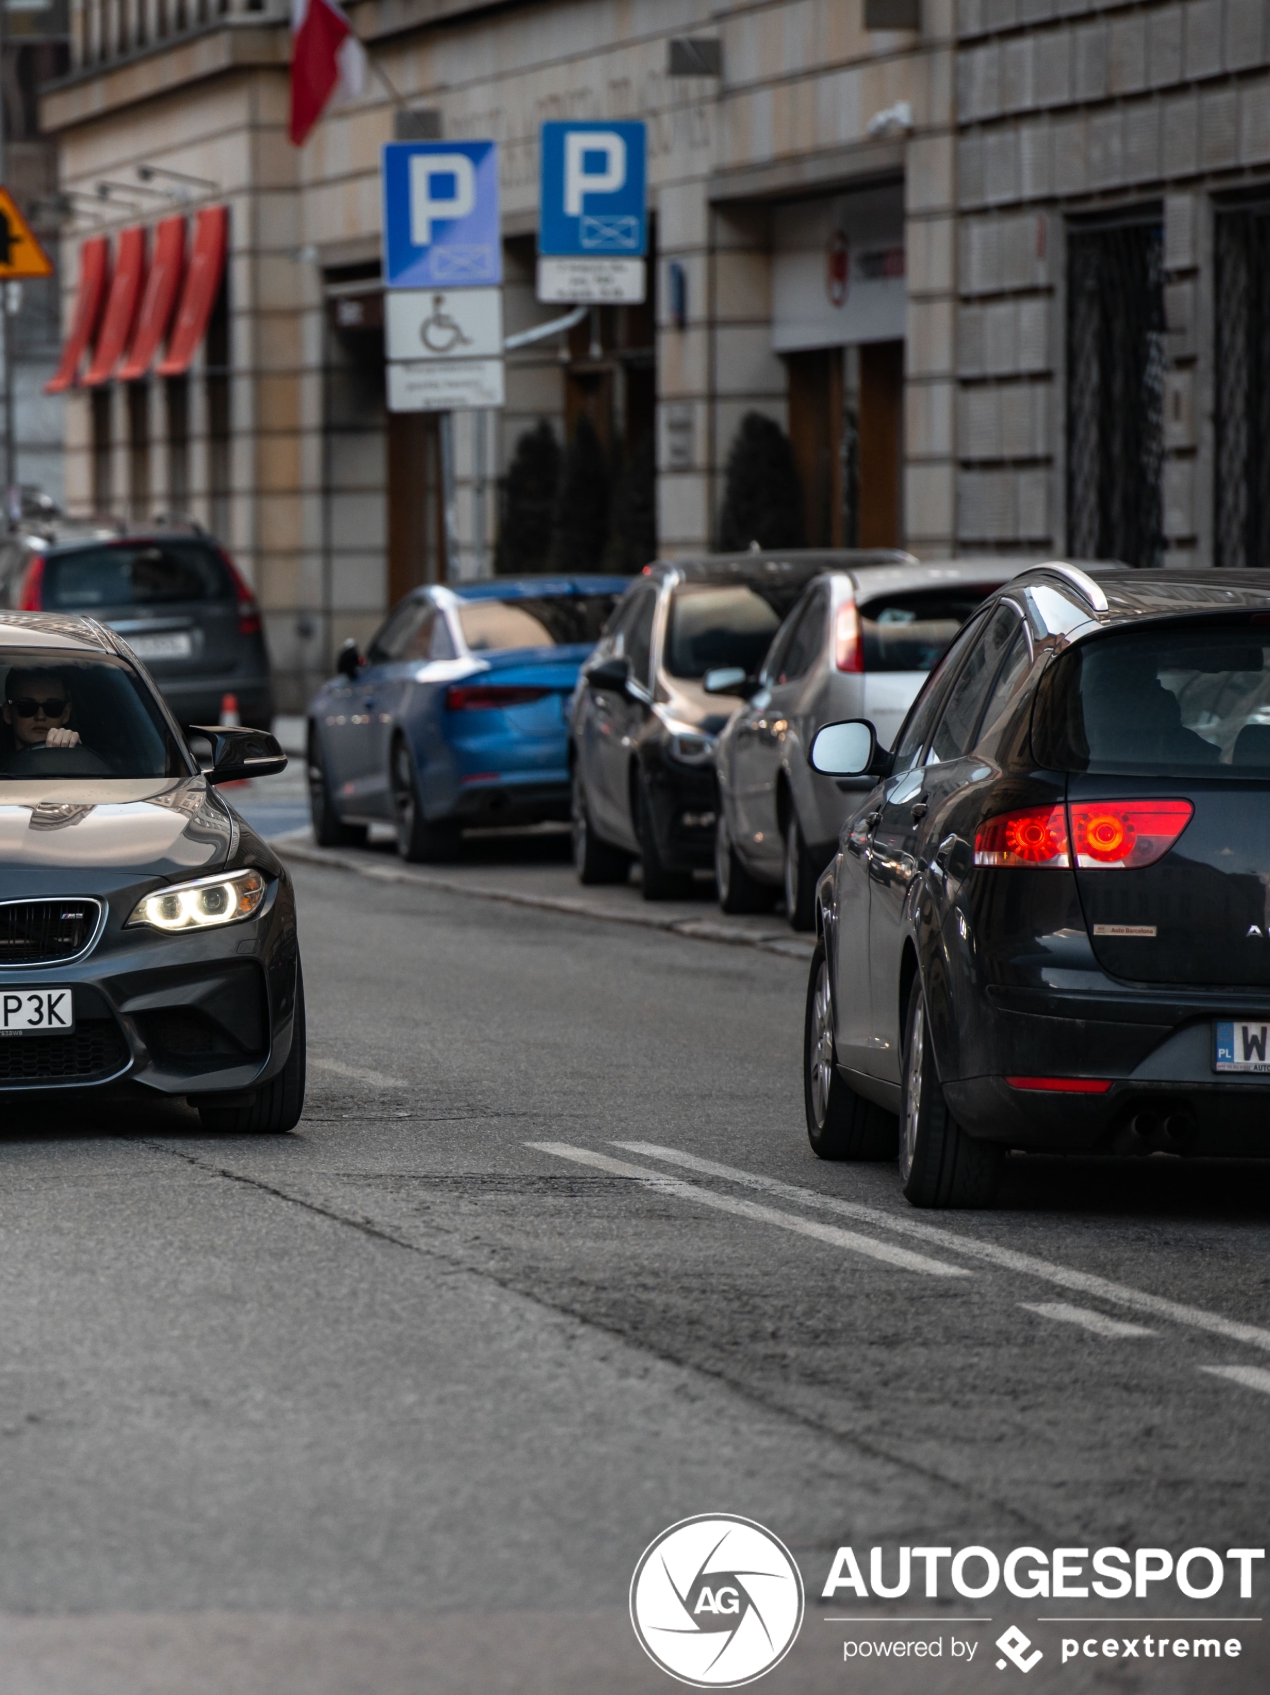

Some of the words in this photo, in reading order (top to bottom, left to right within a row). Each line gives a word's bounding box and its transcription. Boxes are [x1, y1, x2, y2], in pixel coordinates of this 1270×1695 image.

[564, 131, 628, 217] P
[409, 153, 476, 246] P
[1125, 927, 1154, 935] Barcelona
[1218, 1048, 1232, 1059] PL
[1241, 1026, 1268, 1061] W
